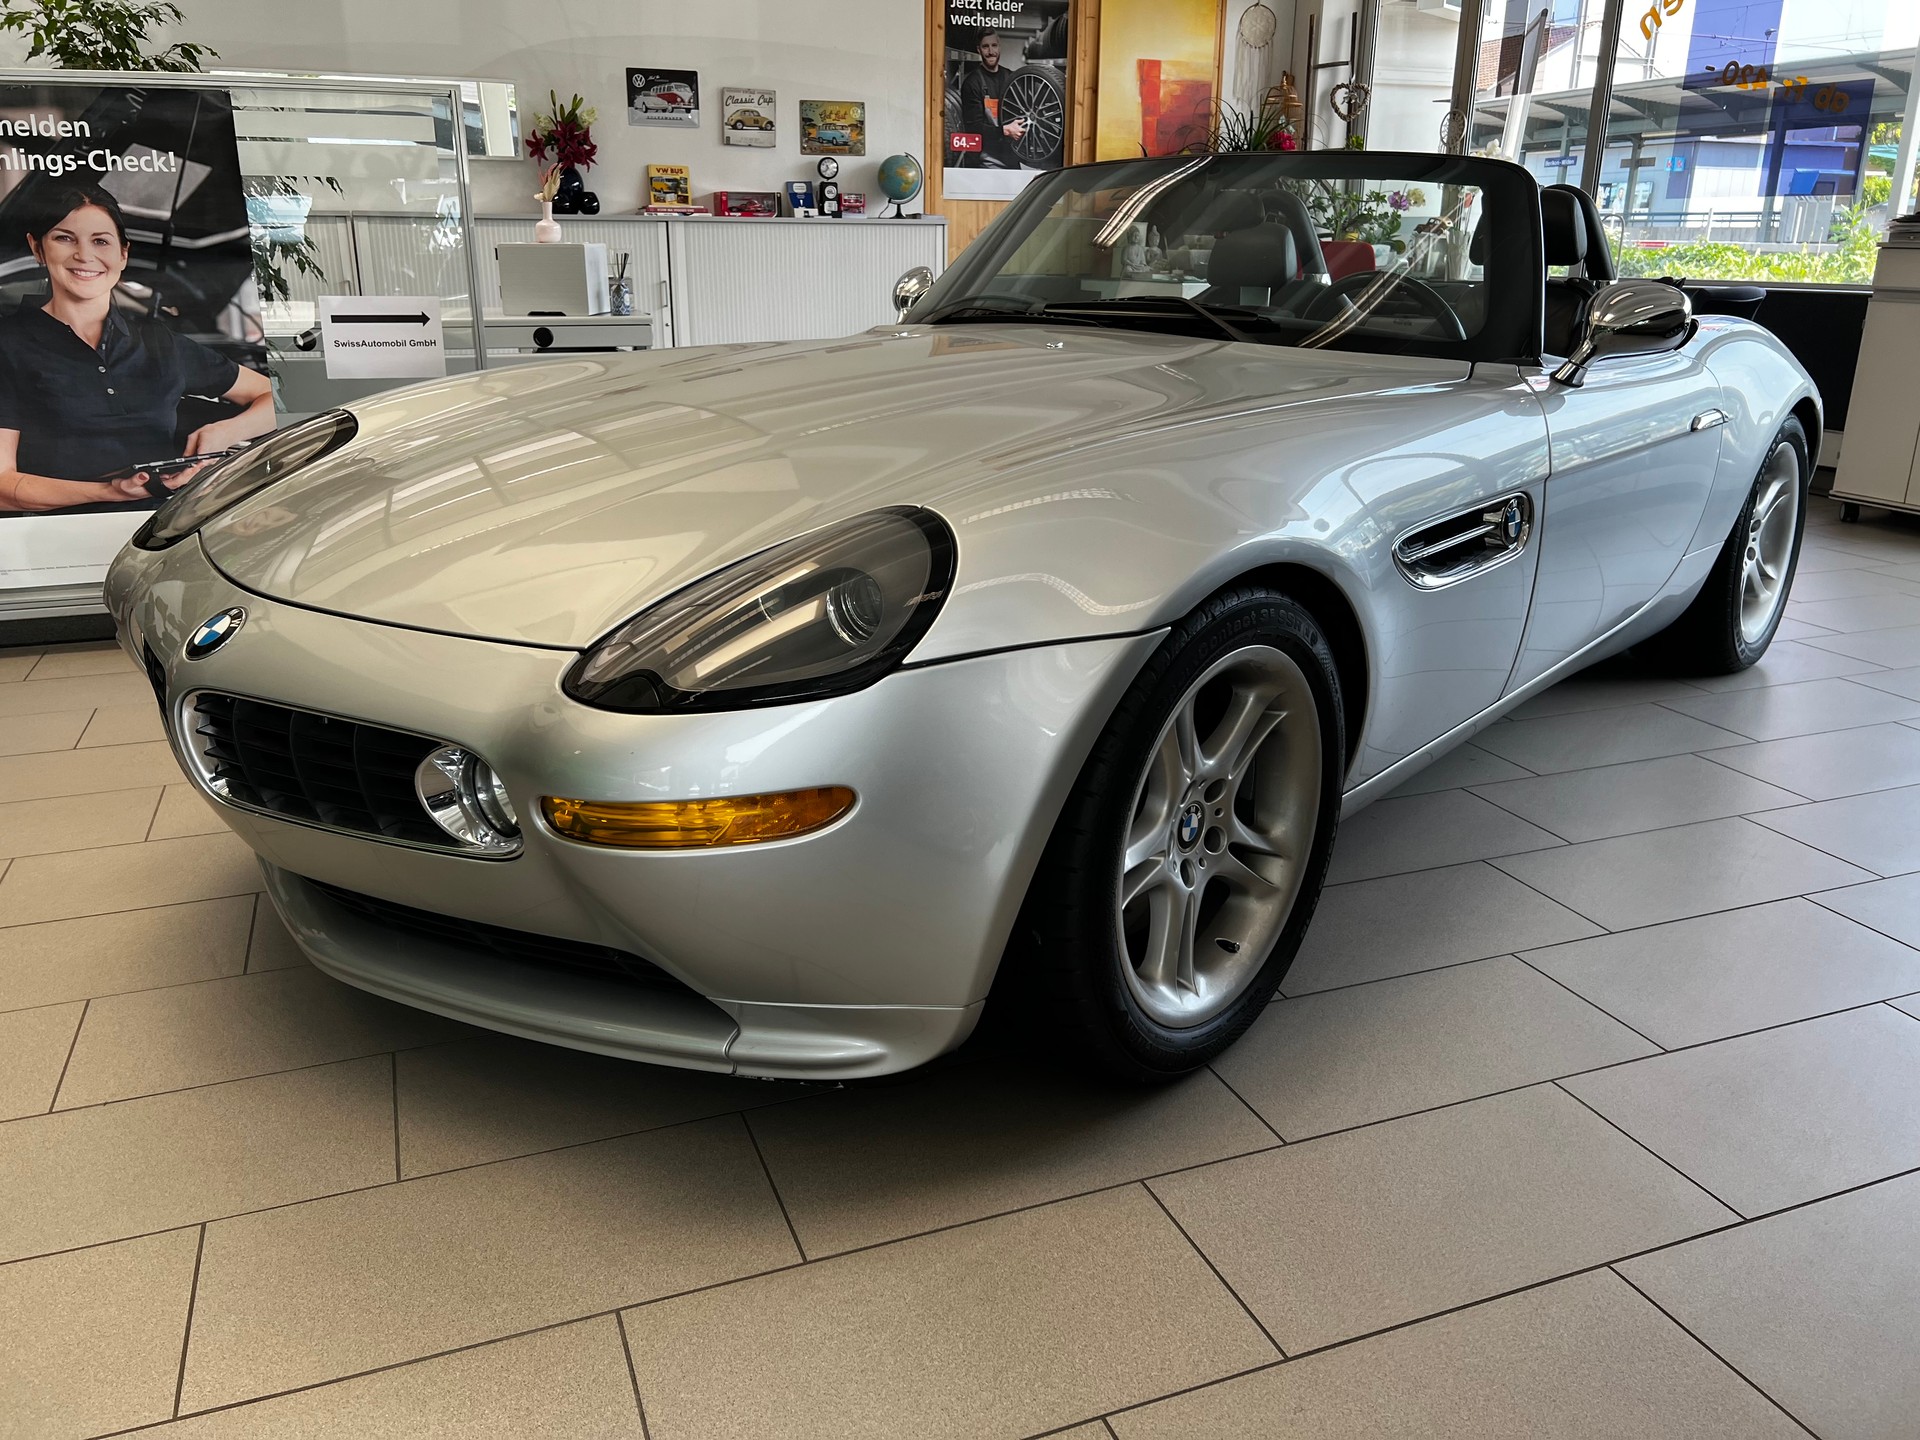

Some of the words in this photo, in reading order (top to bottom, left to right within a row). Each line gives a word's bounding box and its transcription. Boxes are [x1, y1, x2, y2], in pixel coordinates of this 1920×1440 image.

[950, 13, 1015, 28] wechseln!
[725, 95, 755, 106] Classic
[334, 340, 407, 348] SwissAutomobil
[409, 339, 437, 347] GmbH
